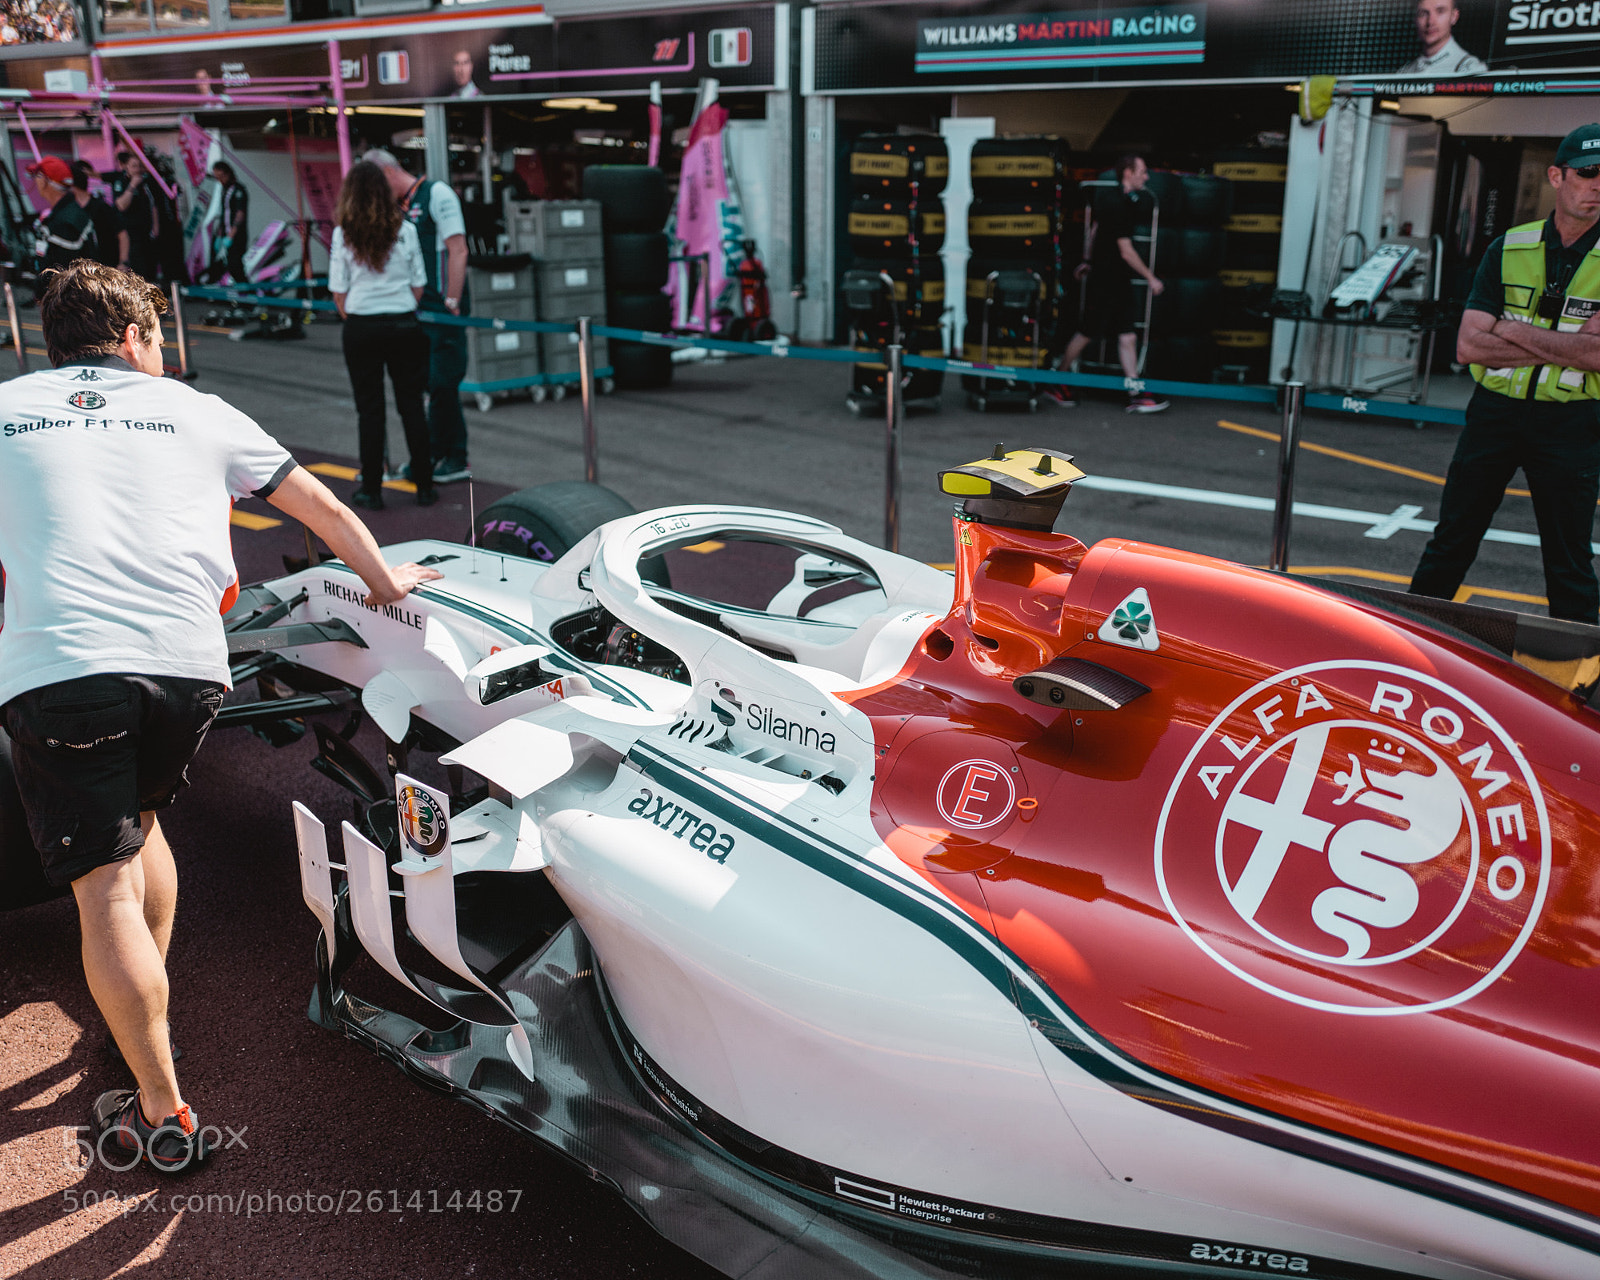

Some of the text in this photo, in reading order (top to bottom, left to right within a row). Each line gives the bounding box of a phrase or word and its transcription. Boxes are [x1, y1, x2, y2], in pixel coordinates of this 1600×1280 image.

[3, 418, 75, 437] Sauber
[120, 419, 175, 434] Team
[650, 523, 666, 535] 16
[382, 602, 423, 631] MILLE
[747, 703, 836, 755] Silanna
[952, 765, 998, 823] E
[1197, 681, 1527, 901] ALFA ROMEO
[414, 788, 446, 830] ROMEO
[899, 1194, 985, 1220] Hewlett Packard
[899, 1204, 952, 1224] Enterprise
